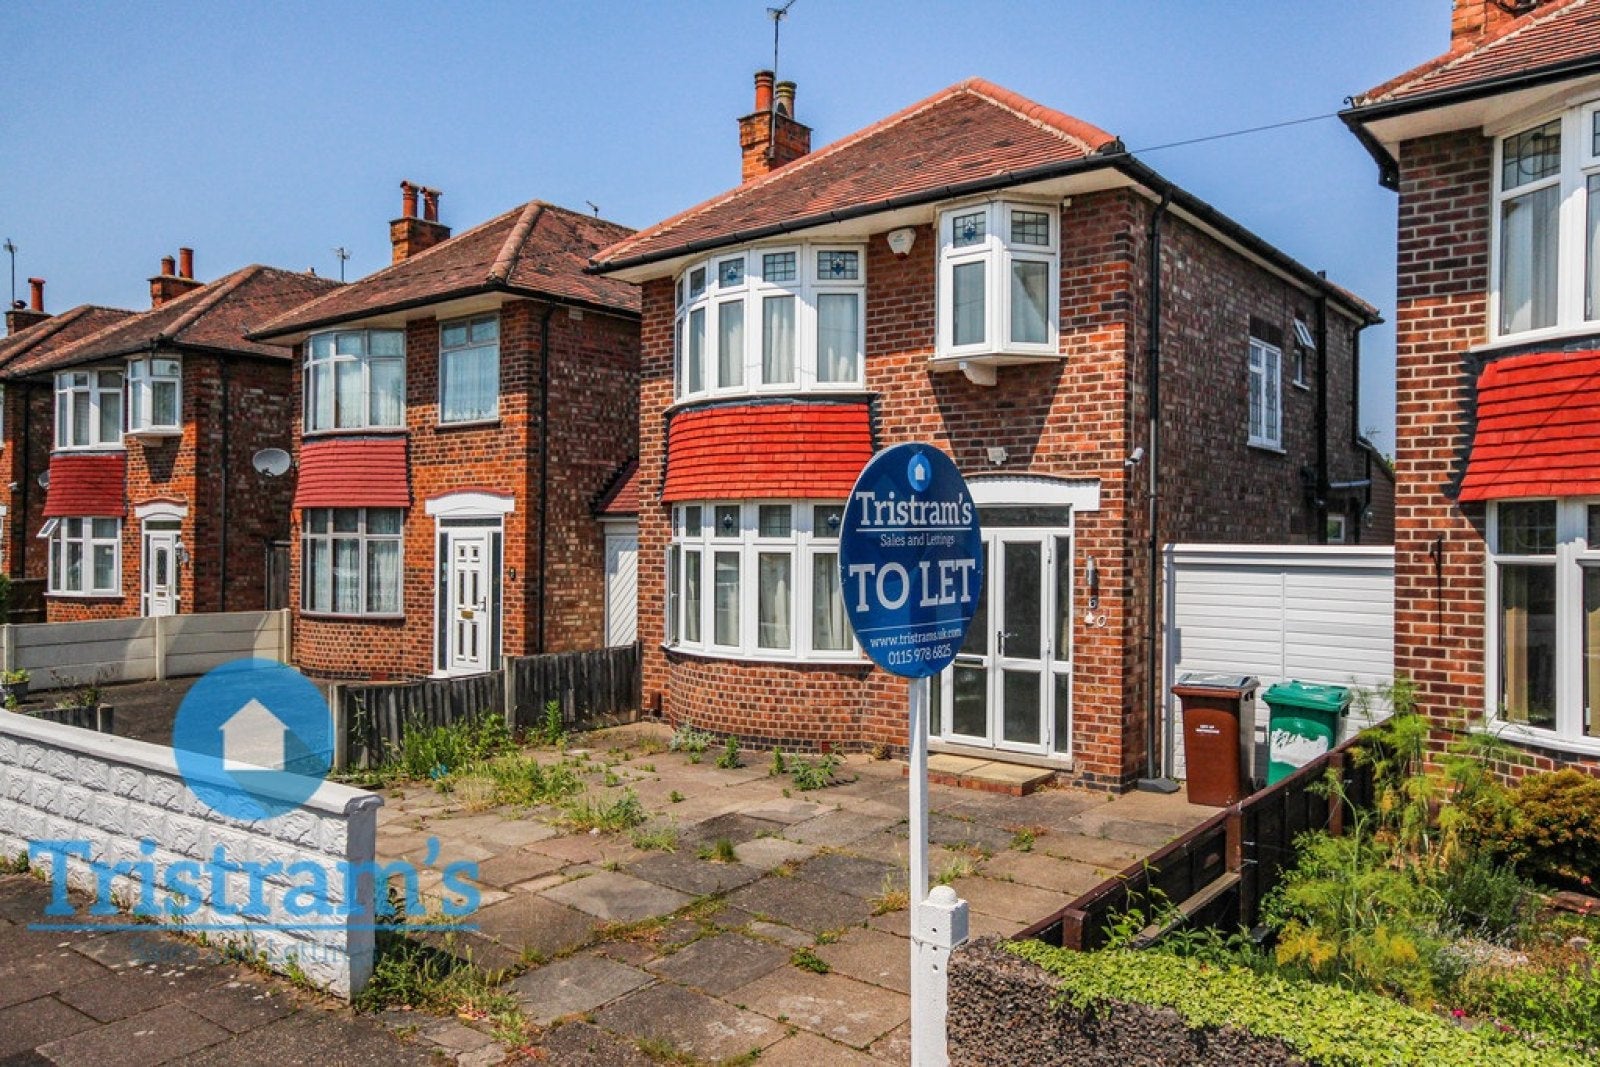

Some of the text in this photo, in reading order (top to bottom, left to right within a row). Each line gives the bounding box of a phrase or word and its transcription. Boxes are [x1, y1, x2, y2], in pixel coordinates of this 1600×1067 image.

[856, 491, 972, 526] Tristram's
[880, 533, 955, 548] Sales and Lettings
[849, 559, 976, 612] TO LET
[888, 644, 952, 666] 0115 978 6825
